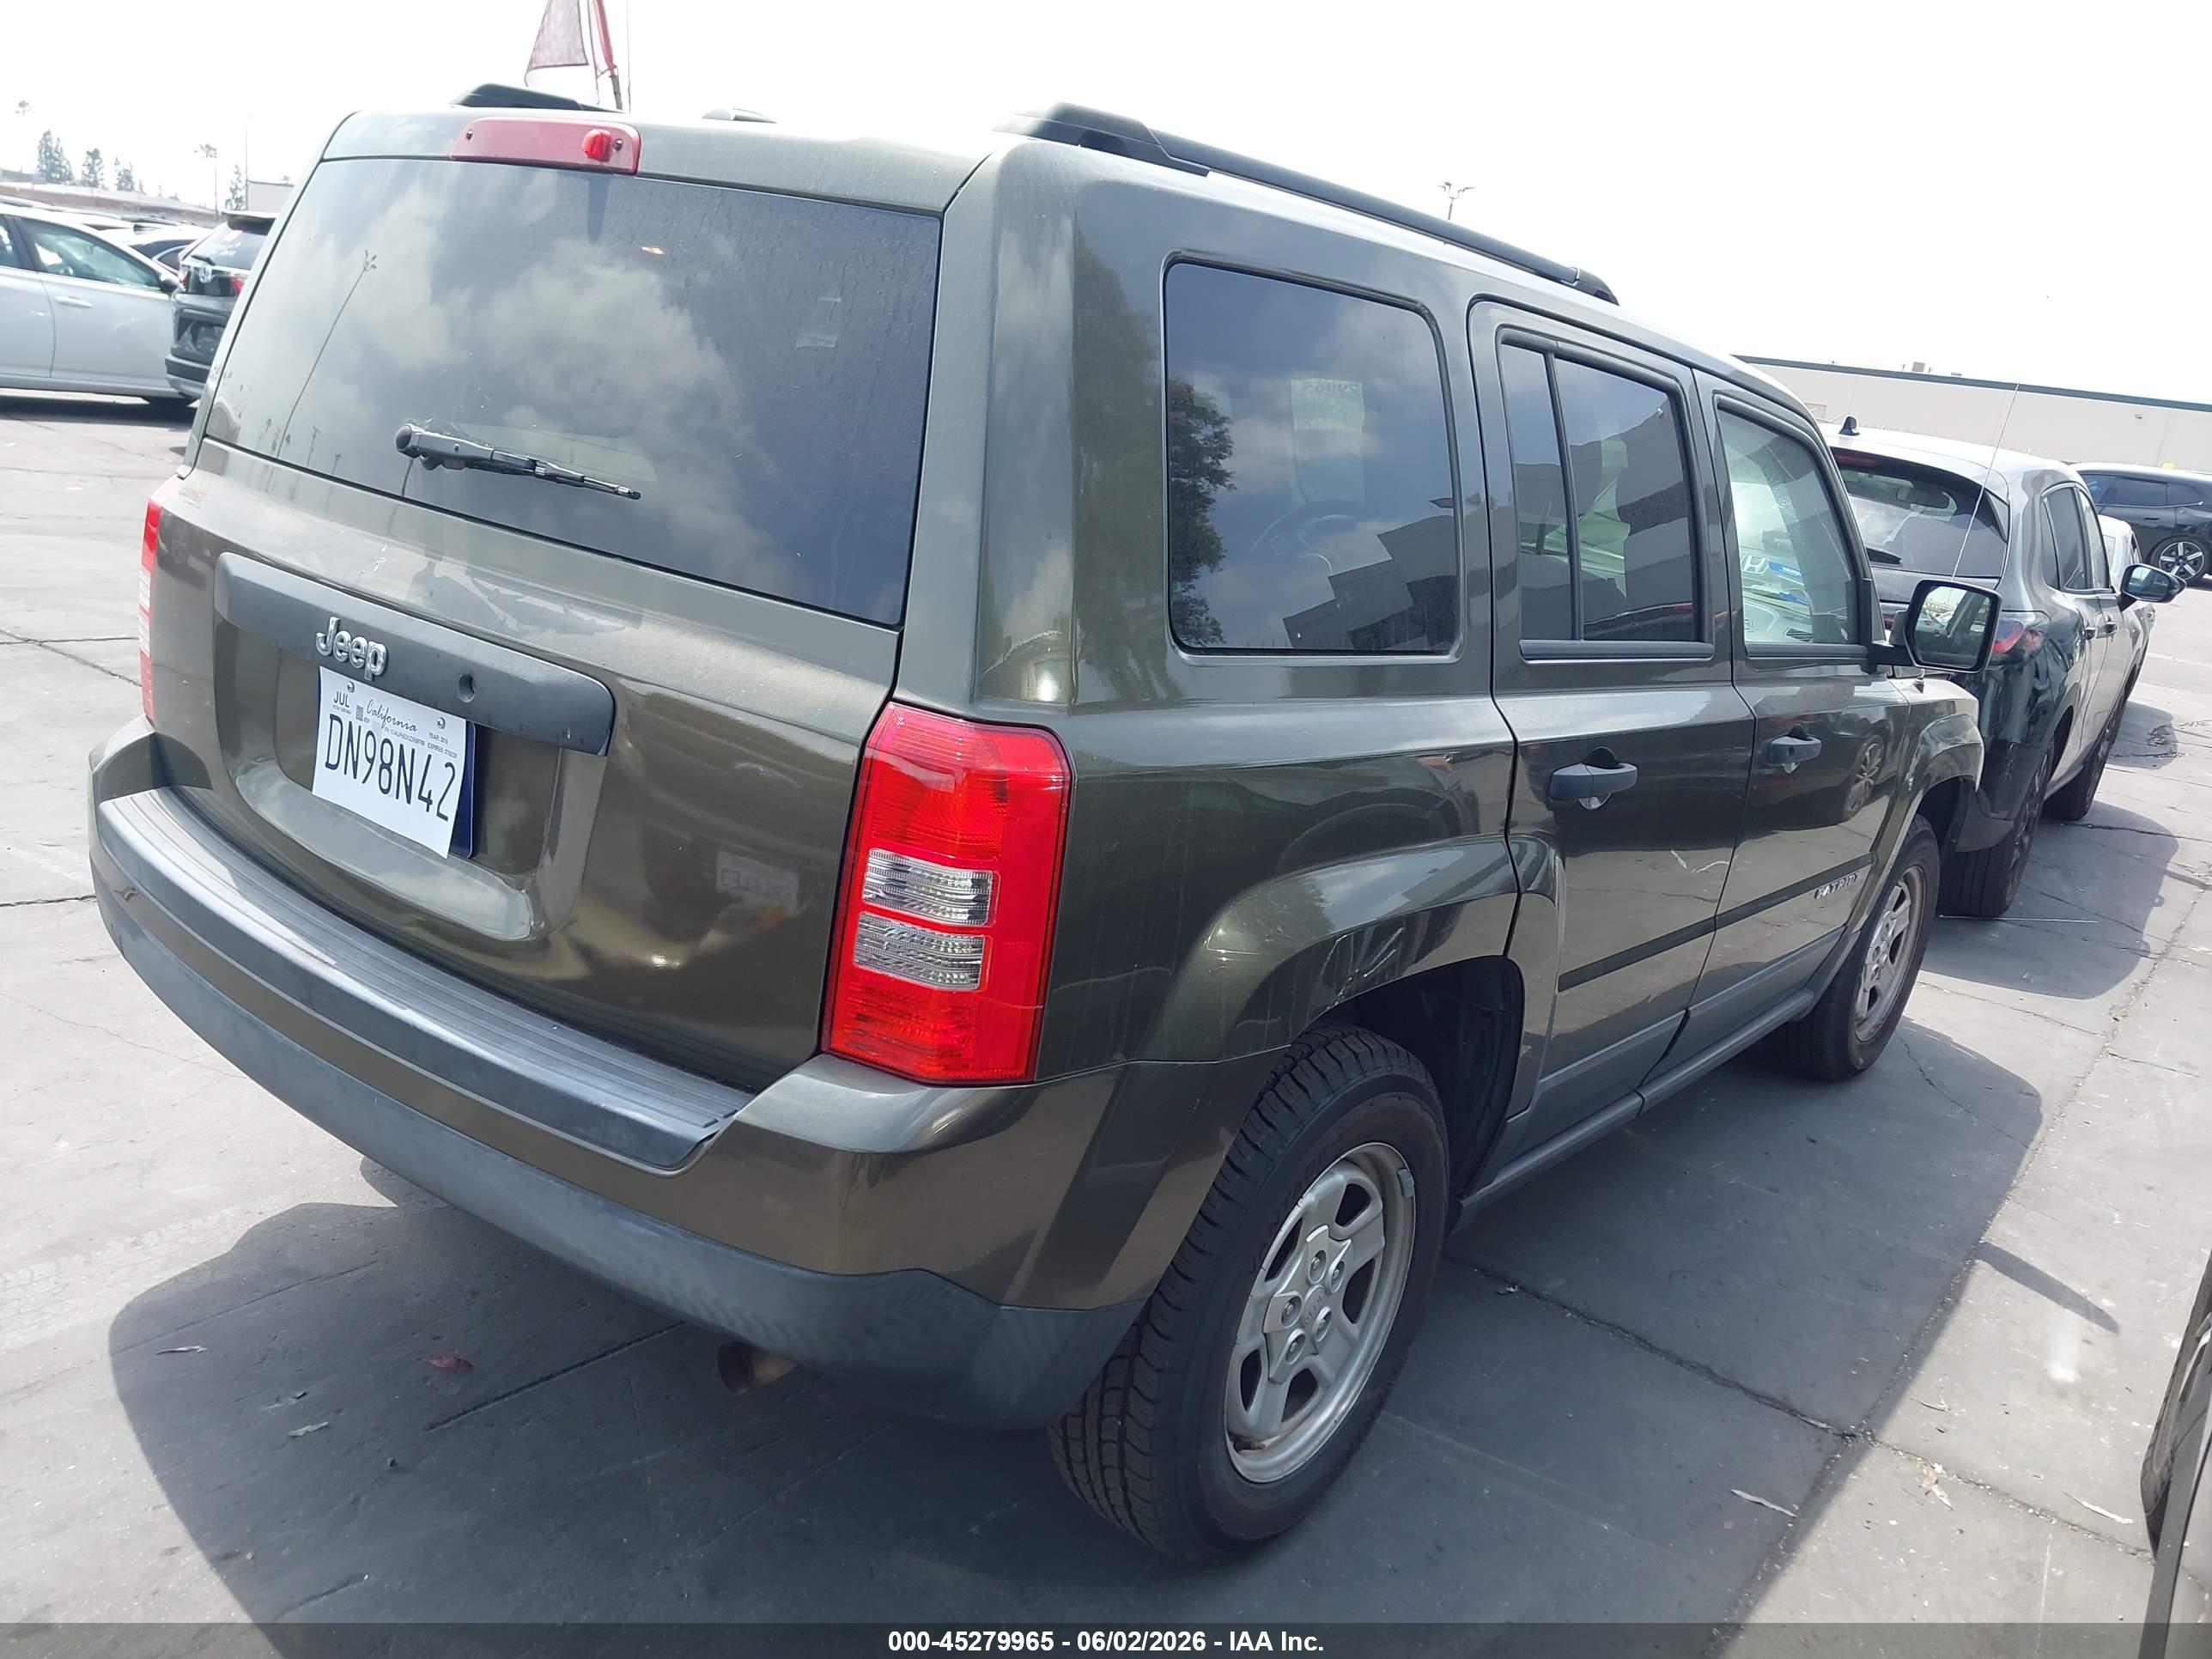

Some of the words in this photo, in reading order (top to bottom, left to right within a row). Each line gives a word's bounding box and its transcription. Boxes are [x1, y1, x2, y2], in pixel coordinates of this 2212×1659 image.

[315, 616, 388, 682] Jeep
[333, 690, 350, 708] JUL
[366, 699, 418, 732] California
[325, 713, 457, 822] DN98N42
